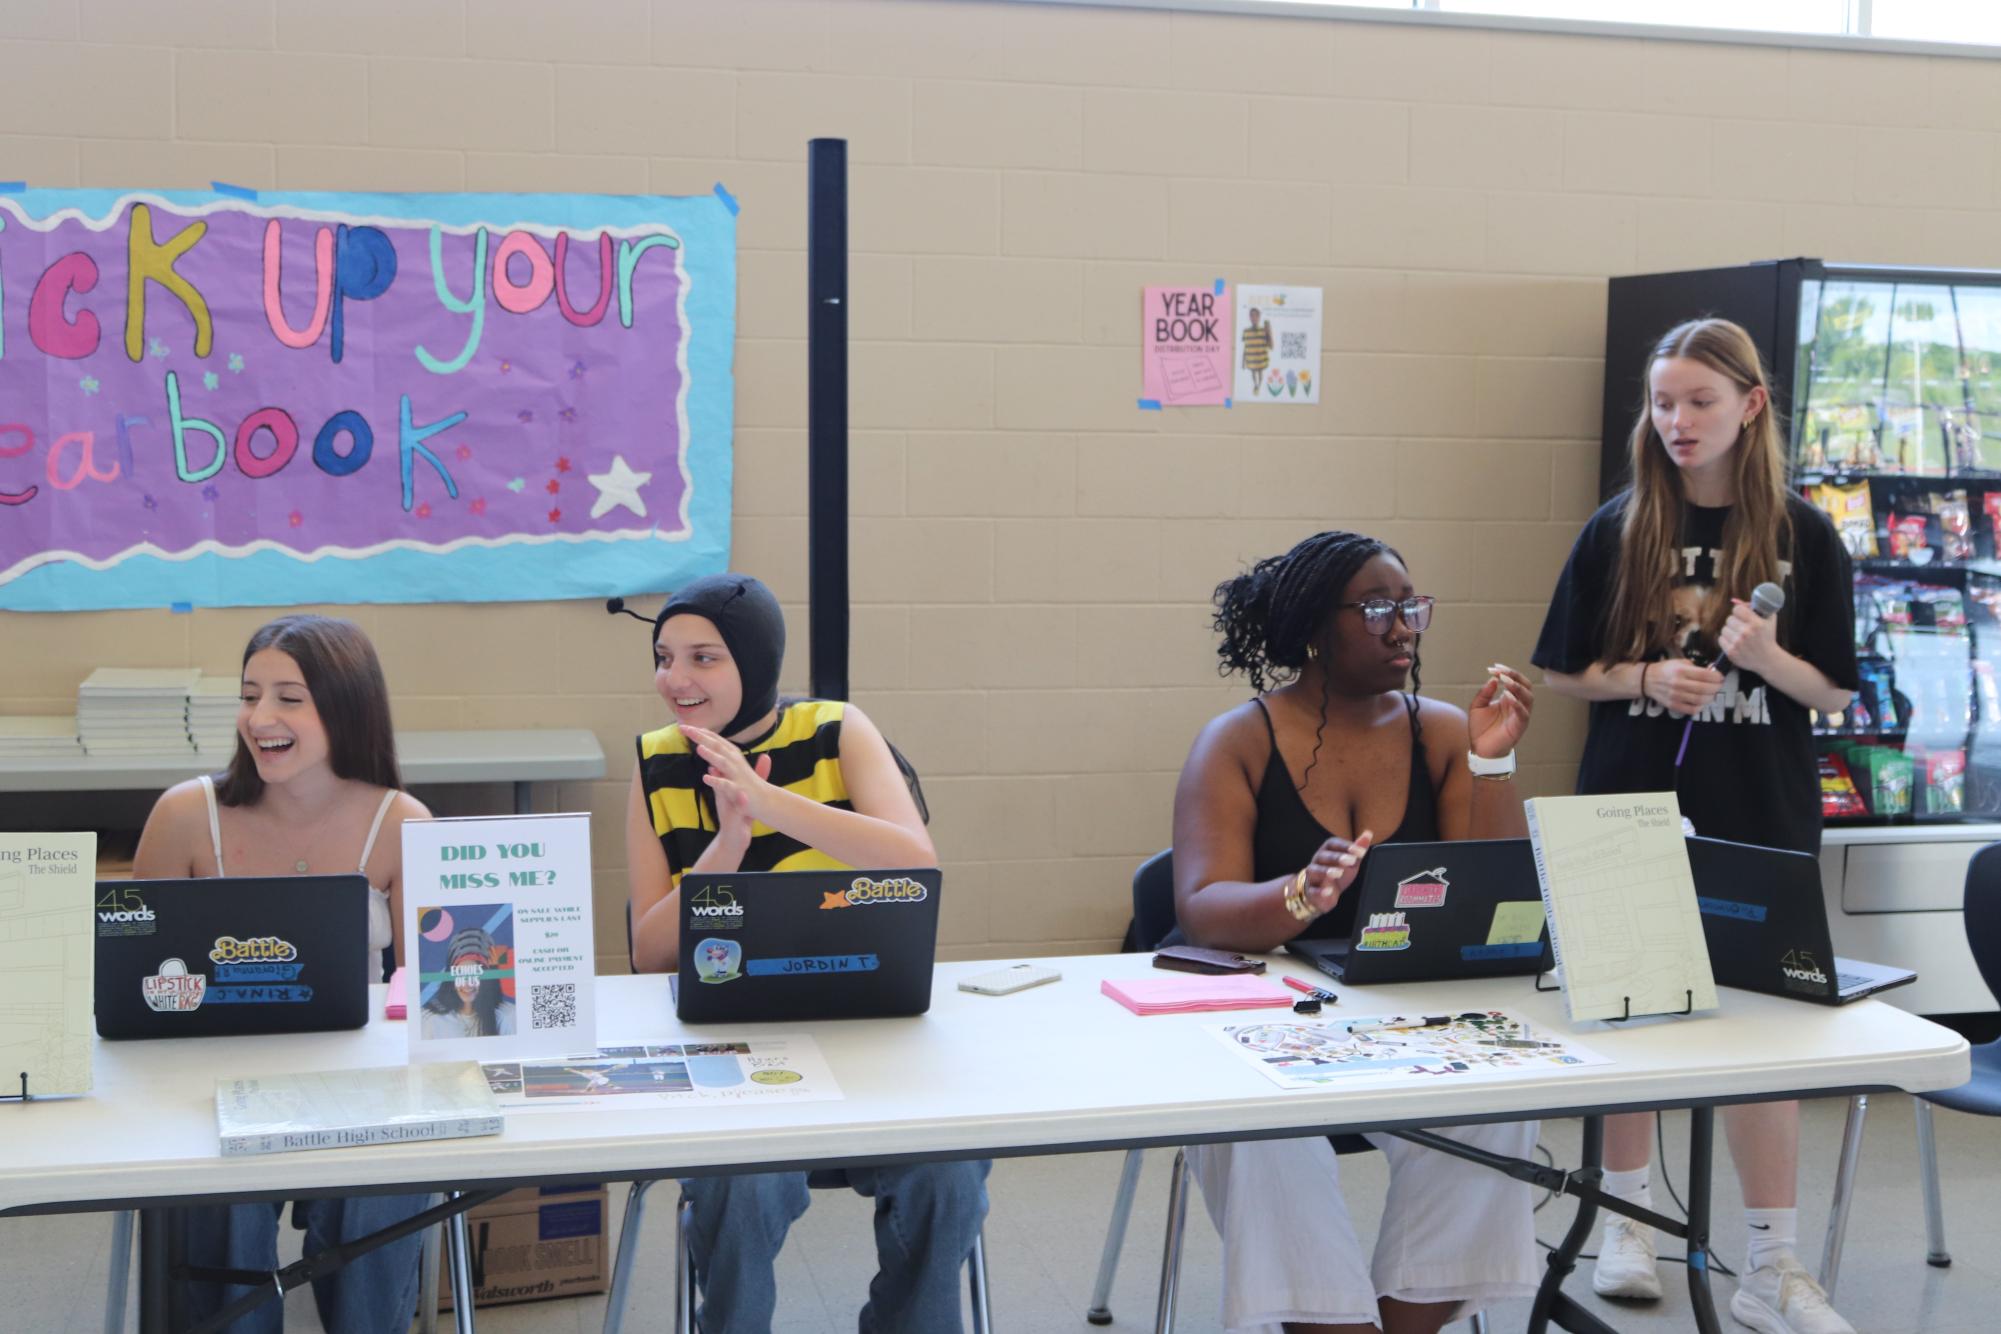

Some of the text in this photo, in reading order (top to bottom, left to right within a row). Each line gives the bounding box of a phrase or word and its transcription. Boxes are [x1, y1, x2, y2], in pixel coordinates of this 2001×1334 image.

[1162, 292, 1215, 317] YEAR
[1156, 318, 1218, 342] BOOK
[1597, 804, 1669, 819] Going Places
[1637, 817, 1670, 828] The Shield
[27, 847, 79, 861] Places
[440, 842, 546, 862] DID YOU
[28, 863, 78, 875] The Shield
[440, 869, 557, 890] MISS ME?
[96, 888, 144, 912] 45
[690, 885, 736, 907] 45
[846, 878, 926, 903] Battle
[98, 904, 156, 923] words
[692, 900, 744, 917] words
[210, 937, 294, 961] Battle
[783, 956, 870, 973] JORDIN T
[146, 977, 203, 991] LIPSTICK
[468, 975, 480, 987] US
[1782, 966, 1828, 984] words
[283, 1131, 331, 1148] Battle
[337, 1128, 374, 1145] High
[381, 1124, 435, 1139] School
